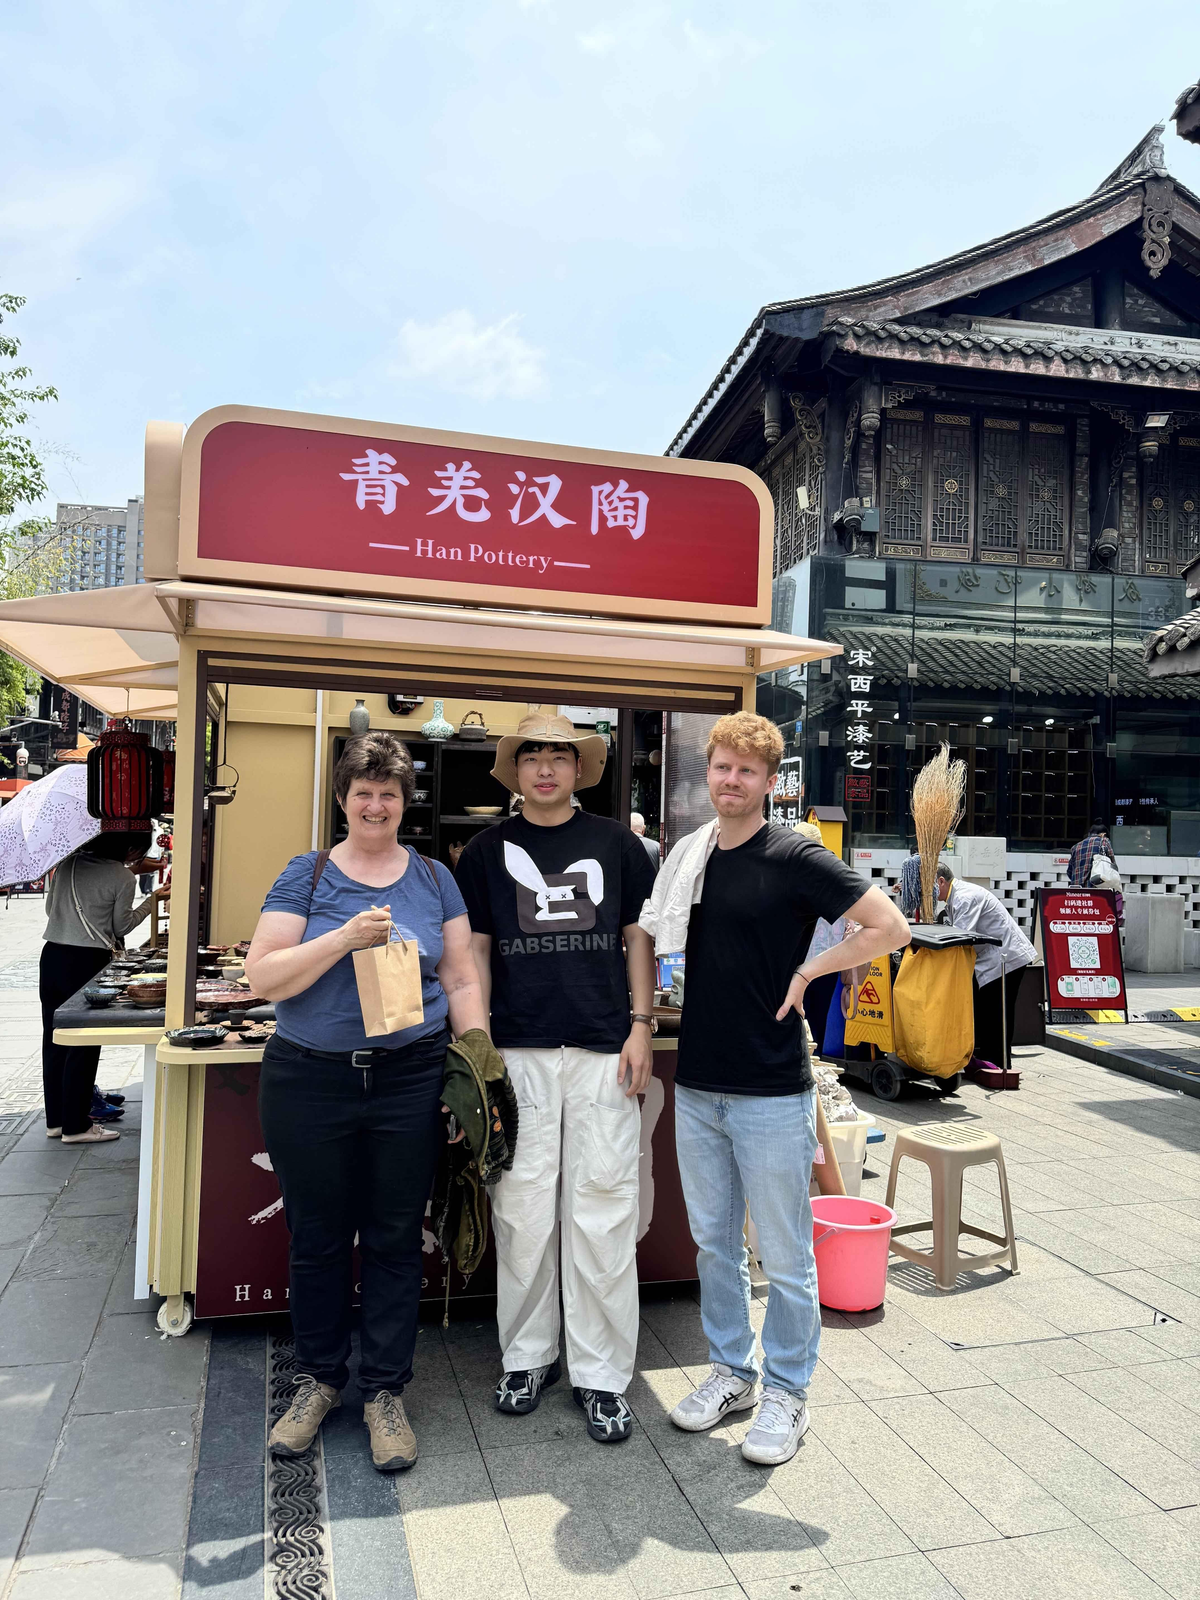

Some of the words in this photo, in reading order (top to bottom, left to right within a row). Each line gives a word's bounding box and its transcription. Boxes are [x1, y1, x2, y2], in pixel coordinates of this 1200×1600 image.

[339, 448, 650, 541] 青羌汉陶
[415, 538, 463, 561] Han
[469, 543, 552, 574] Pottery
[846, 648, 875, 770] 宋西平漆艺
